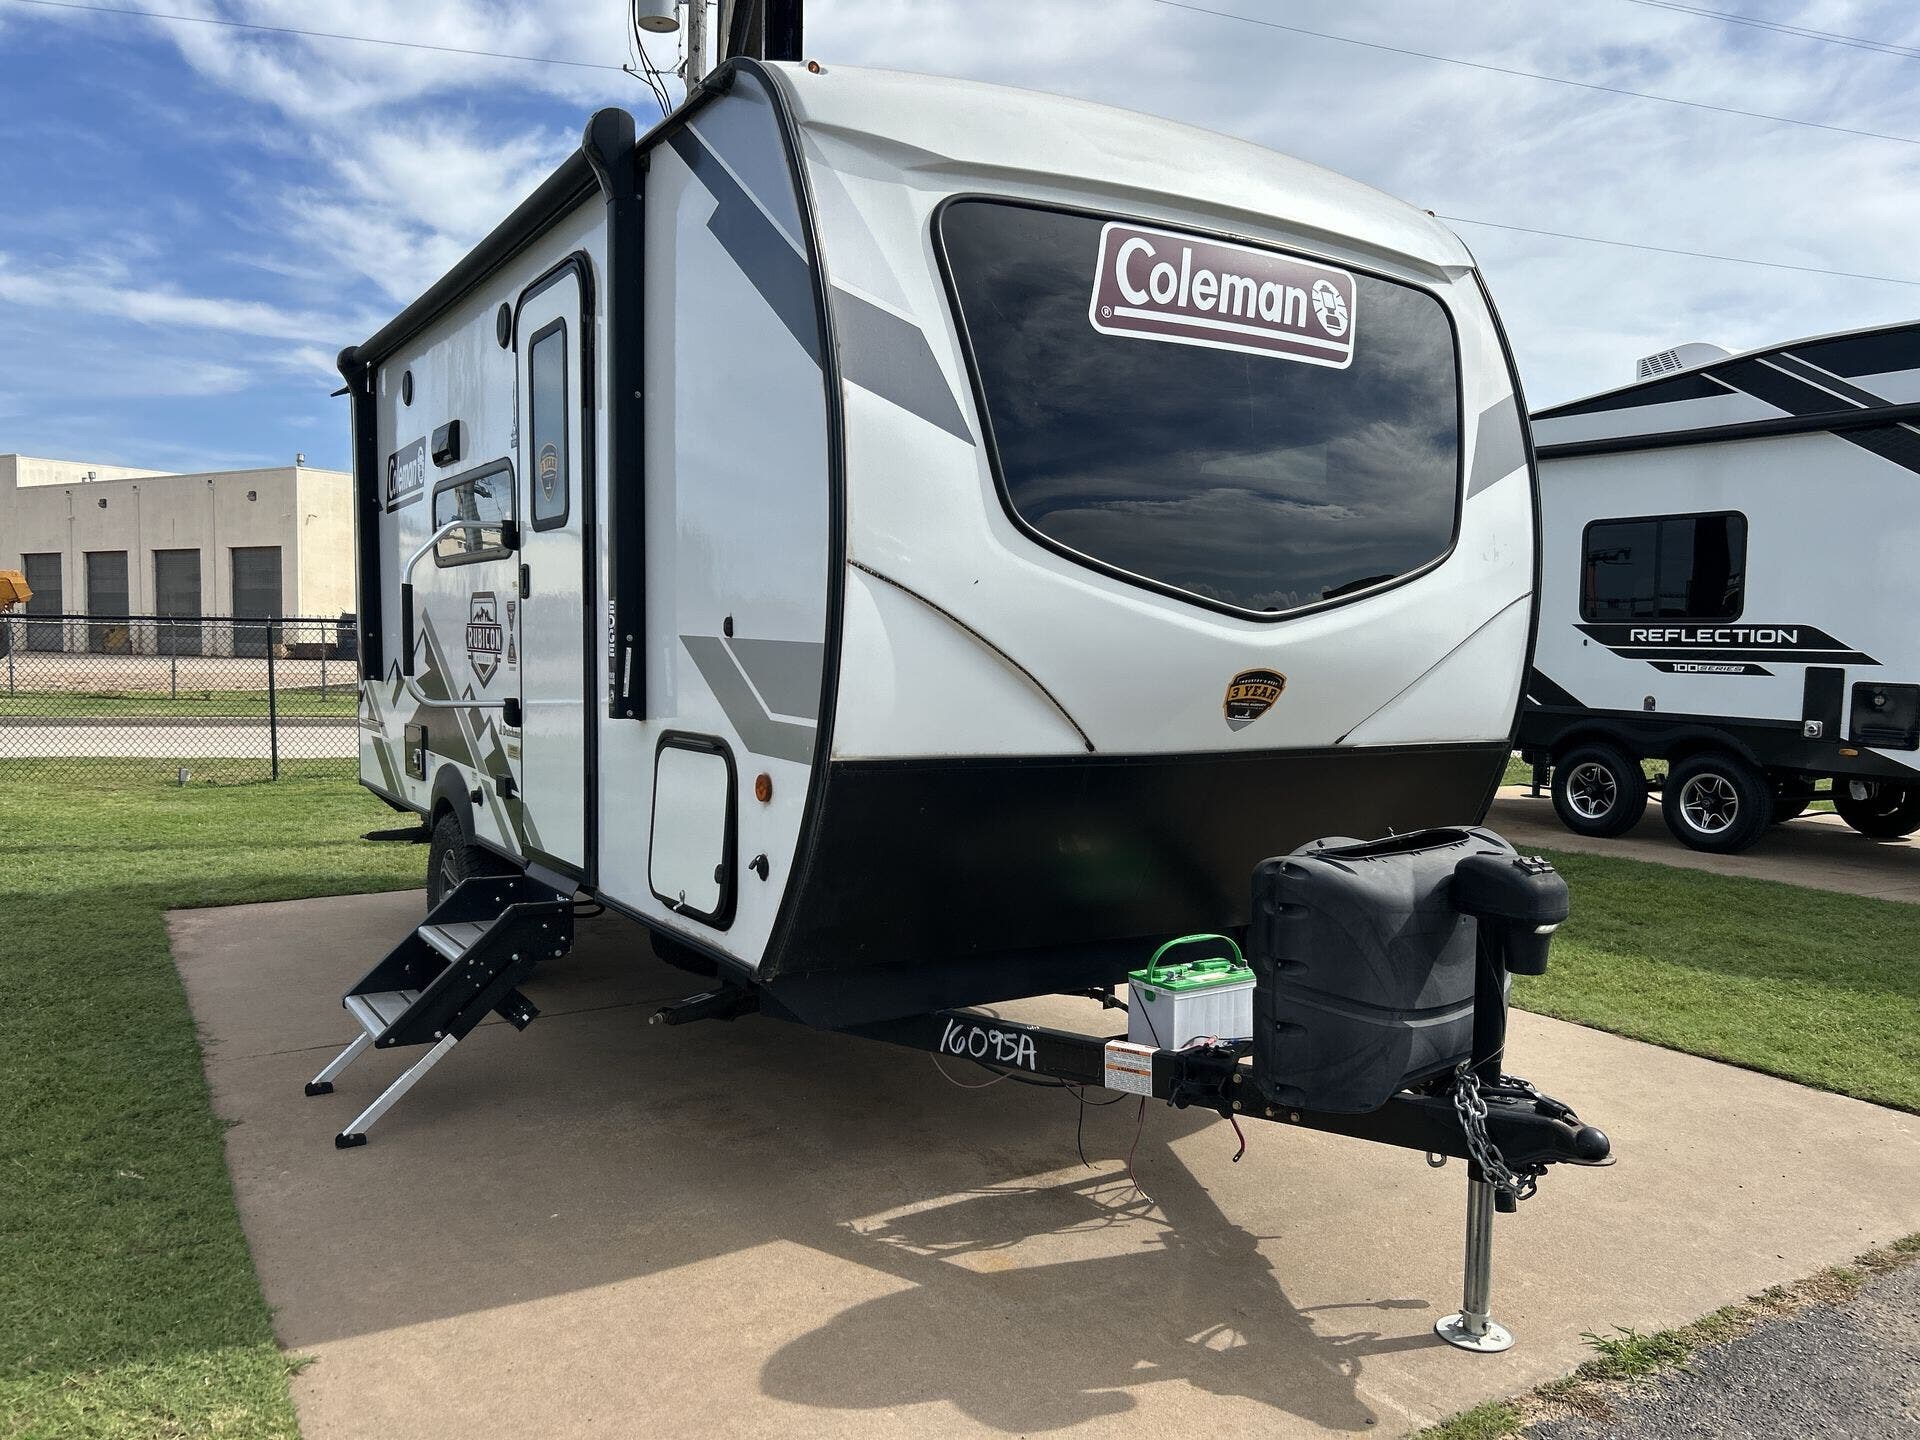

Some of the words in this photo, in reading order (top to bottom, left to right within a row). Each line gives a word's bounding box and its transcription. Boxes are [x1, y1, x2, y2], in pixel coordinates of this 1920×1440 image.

[1115, 237, 1308, 328] Coleman
[389, 455, 417, 499] Coleman
[468, 627, 501, 650] RUBICON
[1630, 629, 1798, 644] REFLECTION
[1231, 687, 1240, 698] 3
[1244, 685, 1278, 701] YEAR
[940, 1018, 1037, 1071] 16095A
